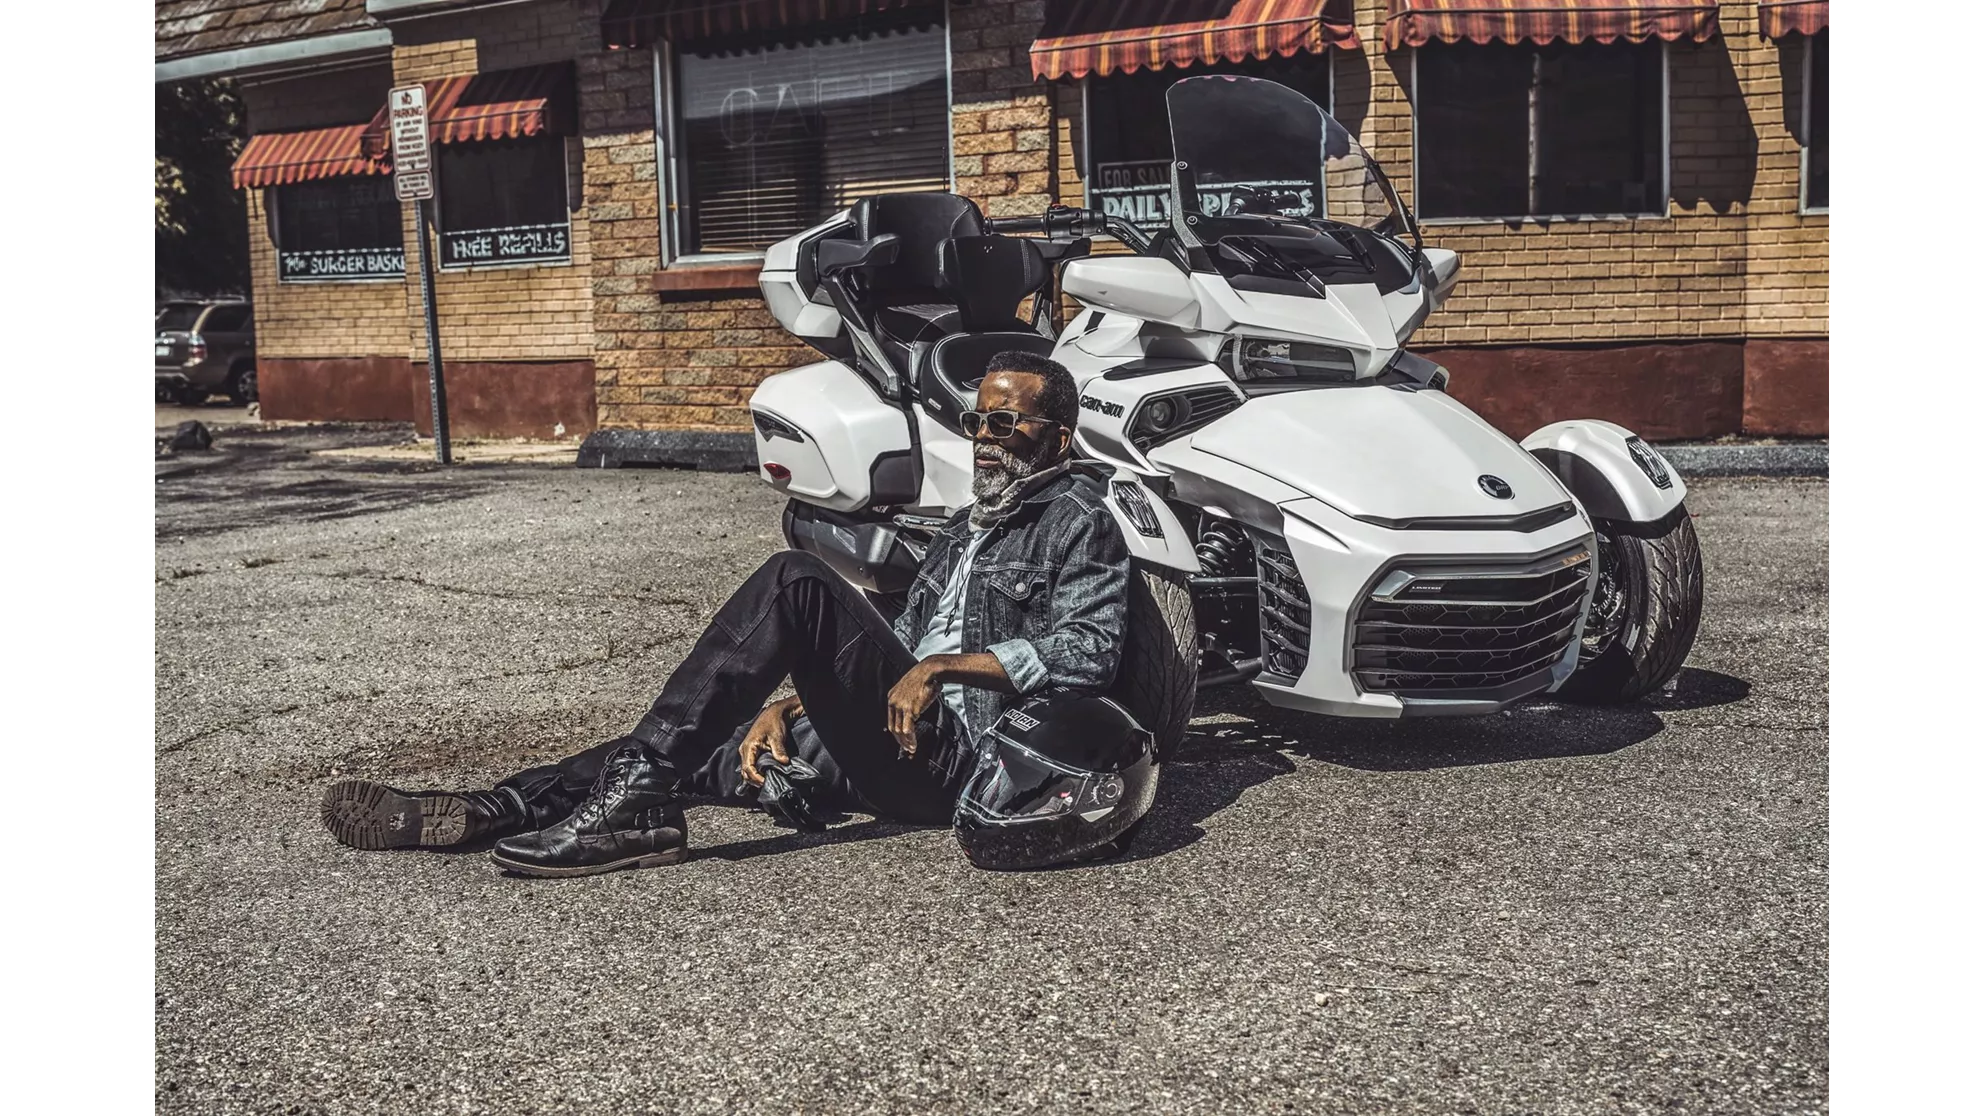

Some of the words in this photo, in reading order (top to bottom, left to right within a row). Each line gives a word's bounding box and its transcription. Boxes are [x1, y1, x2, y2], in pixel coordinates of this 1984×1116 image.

[401, 93, 412, 105] NO
[1104, 169, 1132, 188] FOR
[1103, 193, 1171, 222] DAILY
